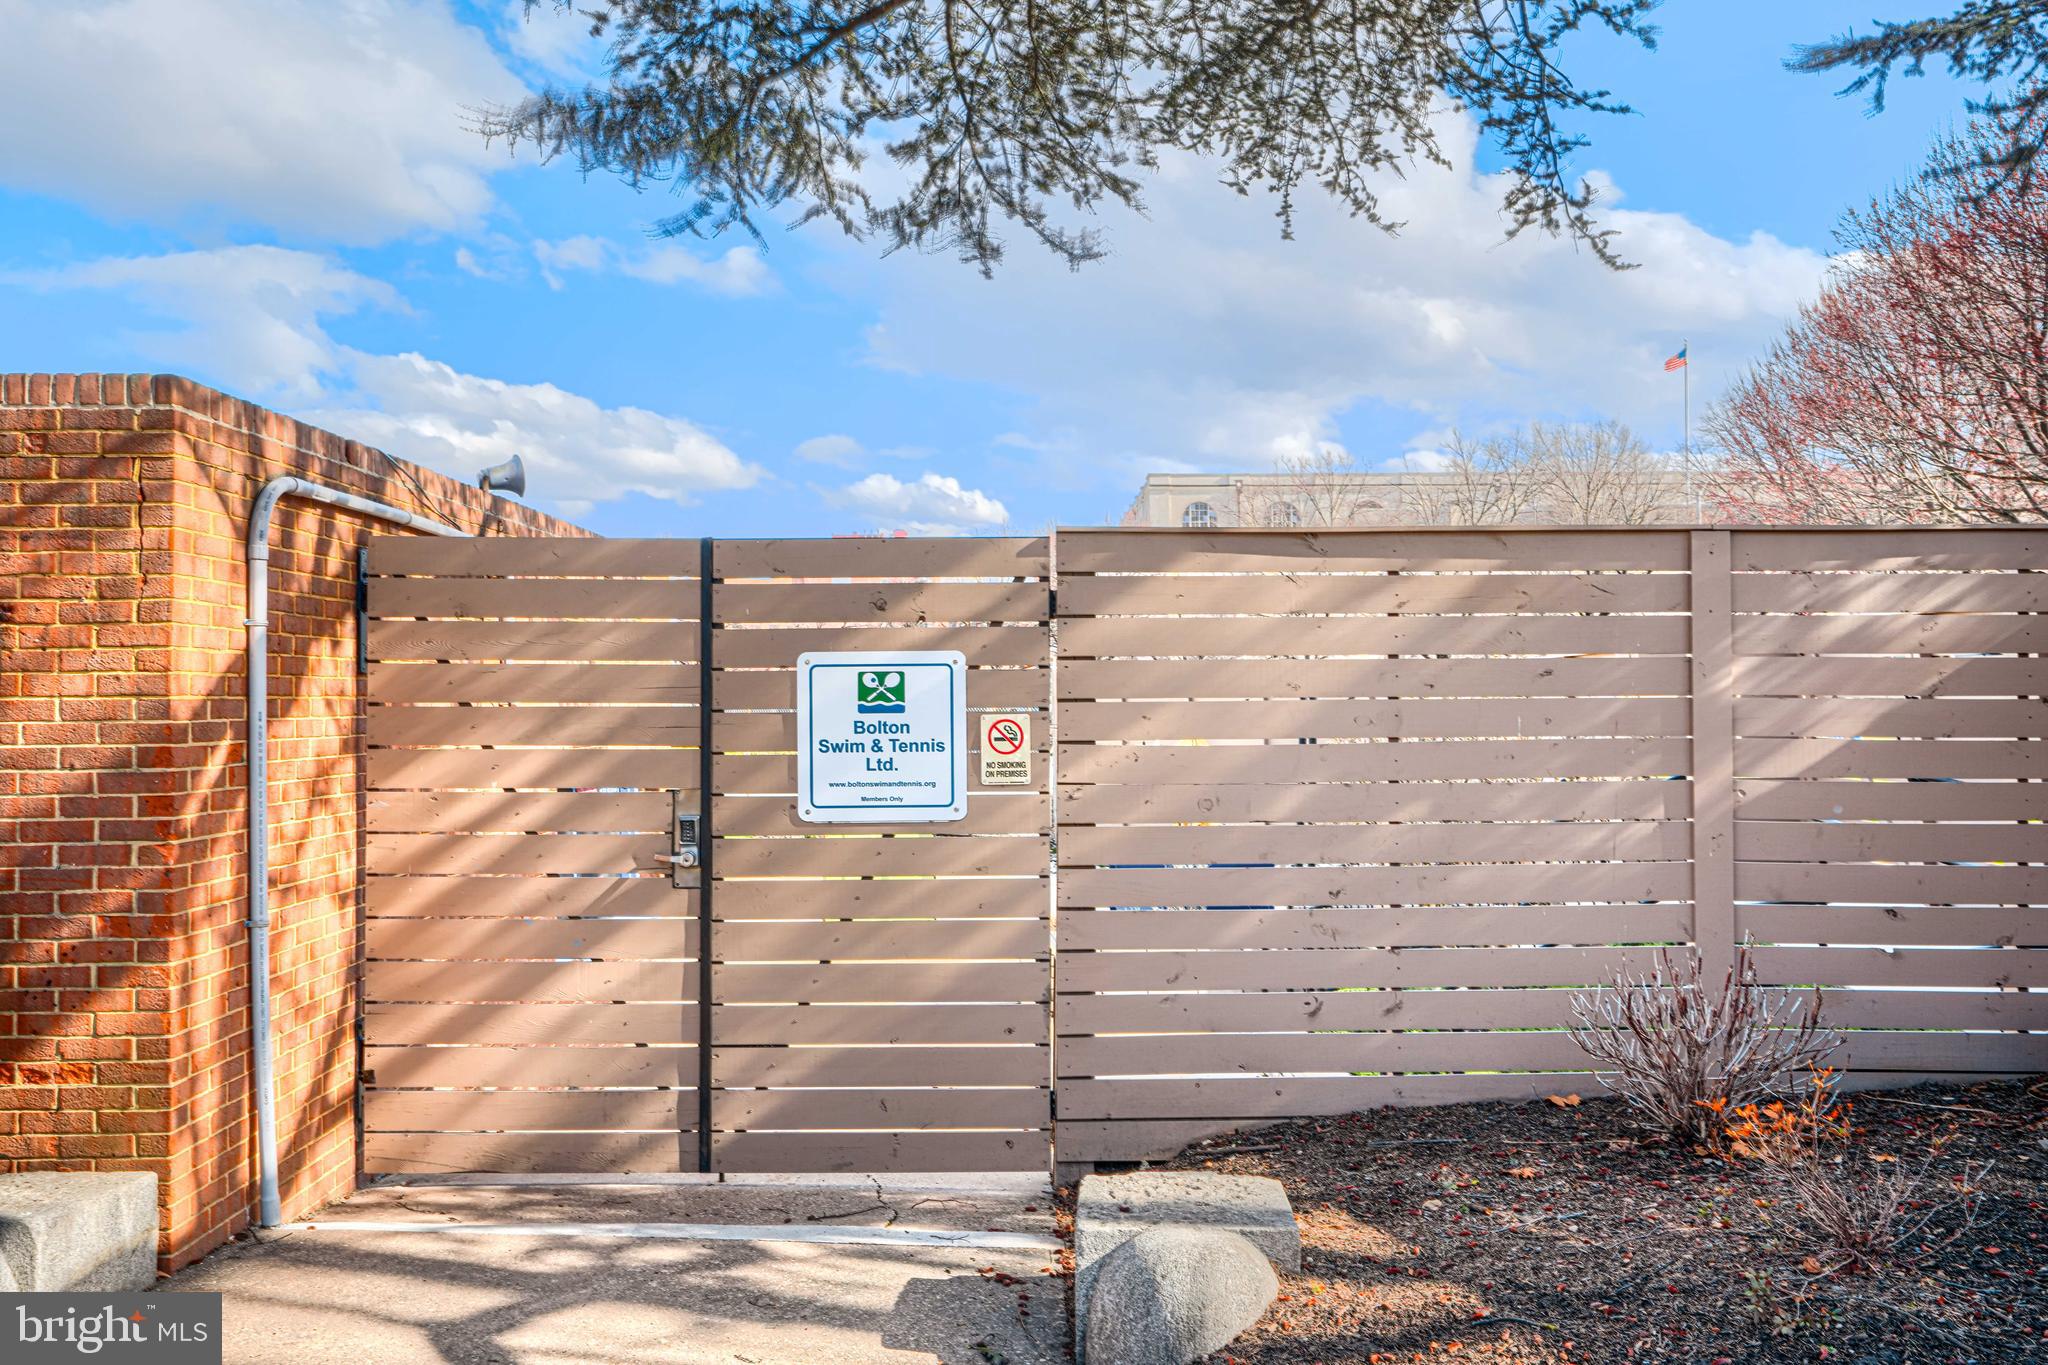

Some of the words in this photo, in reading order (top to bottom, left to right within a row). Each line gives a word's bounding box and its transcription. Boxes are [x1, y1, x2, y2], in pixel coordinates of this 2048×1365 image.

[853, 720, 910, 735] Bolton
[818, 738, 865, 754] Swim
[871, 738, 884, 753] &
[888, 738, 946, 753] Tennis
[866, 757, 898, 772] Ltd.
[986, 761, 996, 769] NO
[997, 761, 1027, 769] SMOKING
[985, 770, 995, 778] ON
[996, 770, 1028, 778] PREMISES
[828, 780, 937, 789] www.boltonswimandtennis.org
